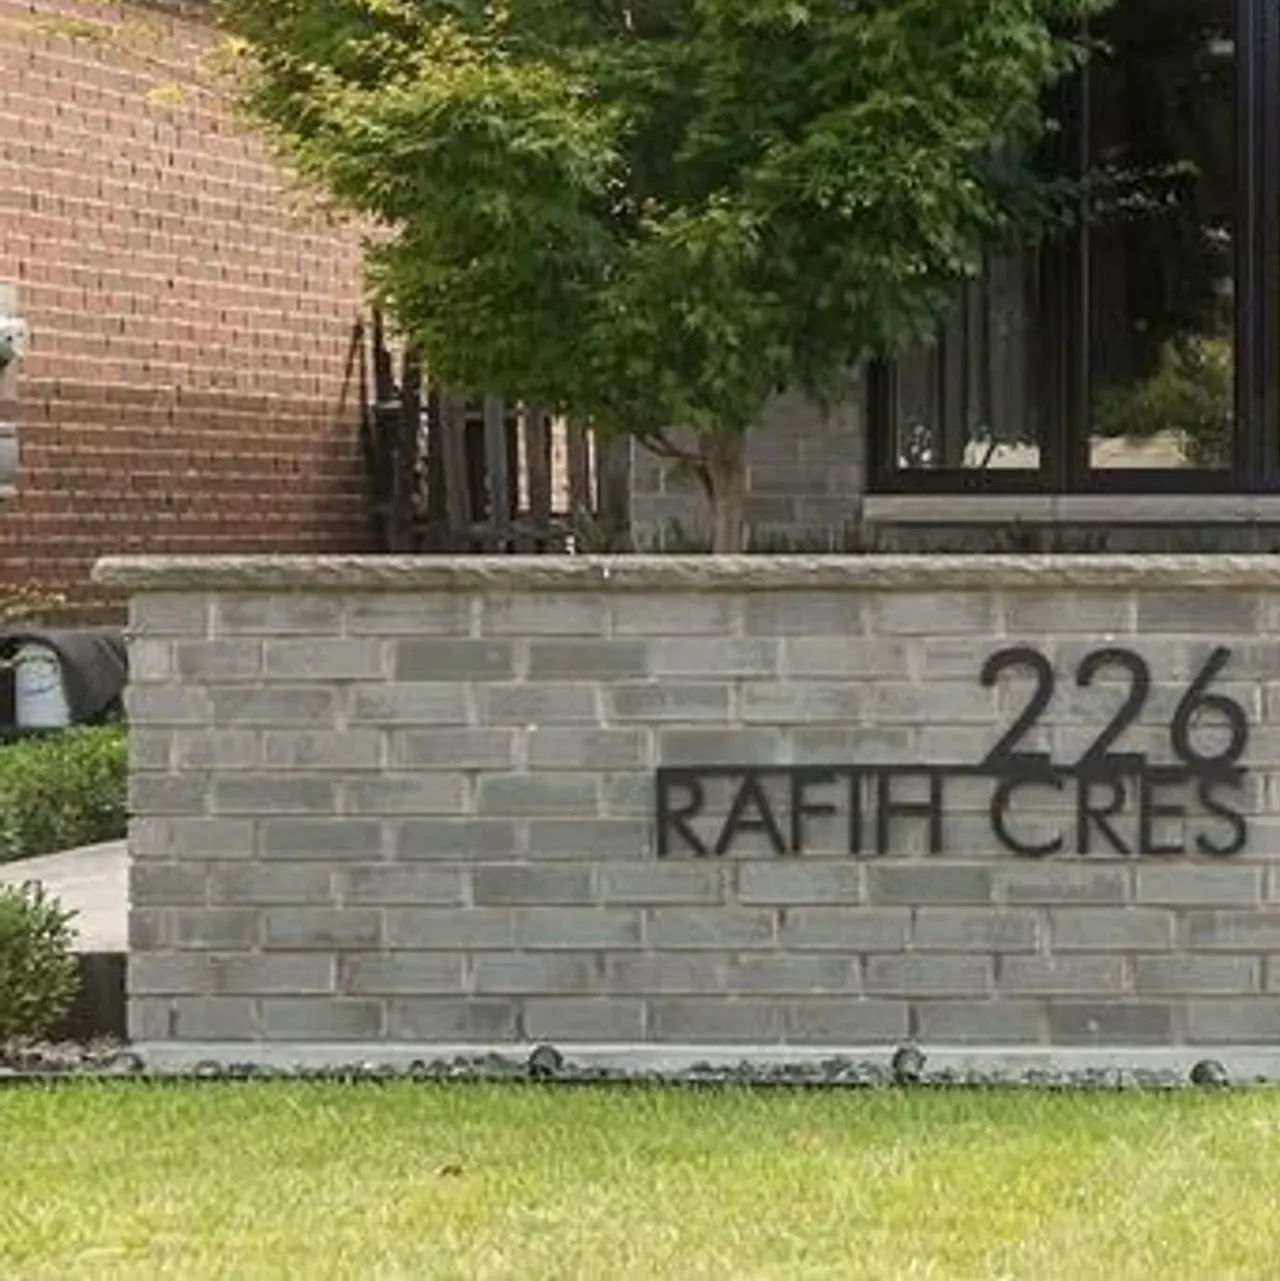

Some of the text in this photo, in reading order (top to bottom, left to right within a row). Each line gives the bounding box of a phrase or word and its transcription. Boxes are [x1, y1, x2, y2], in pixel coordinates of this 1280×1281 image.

[979, 646, 1249, 766] 226
[656, 766, 1248, 857] RAFIH CRES
